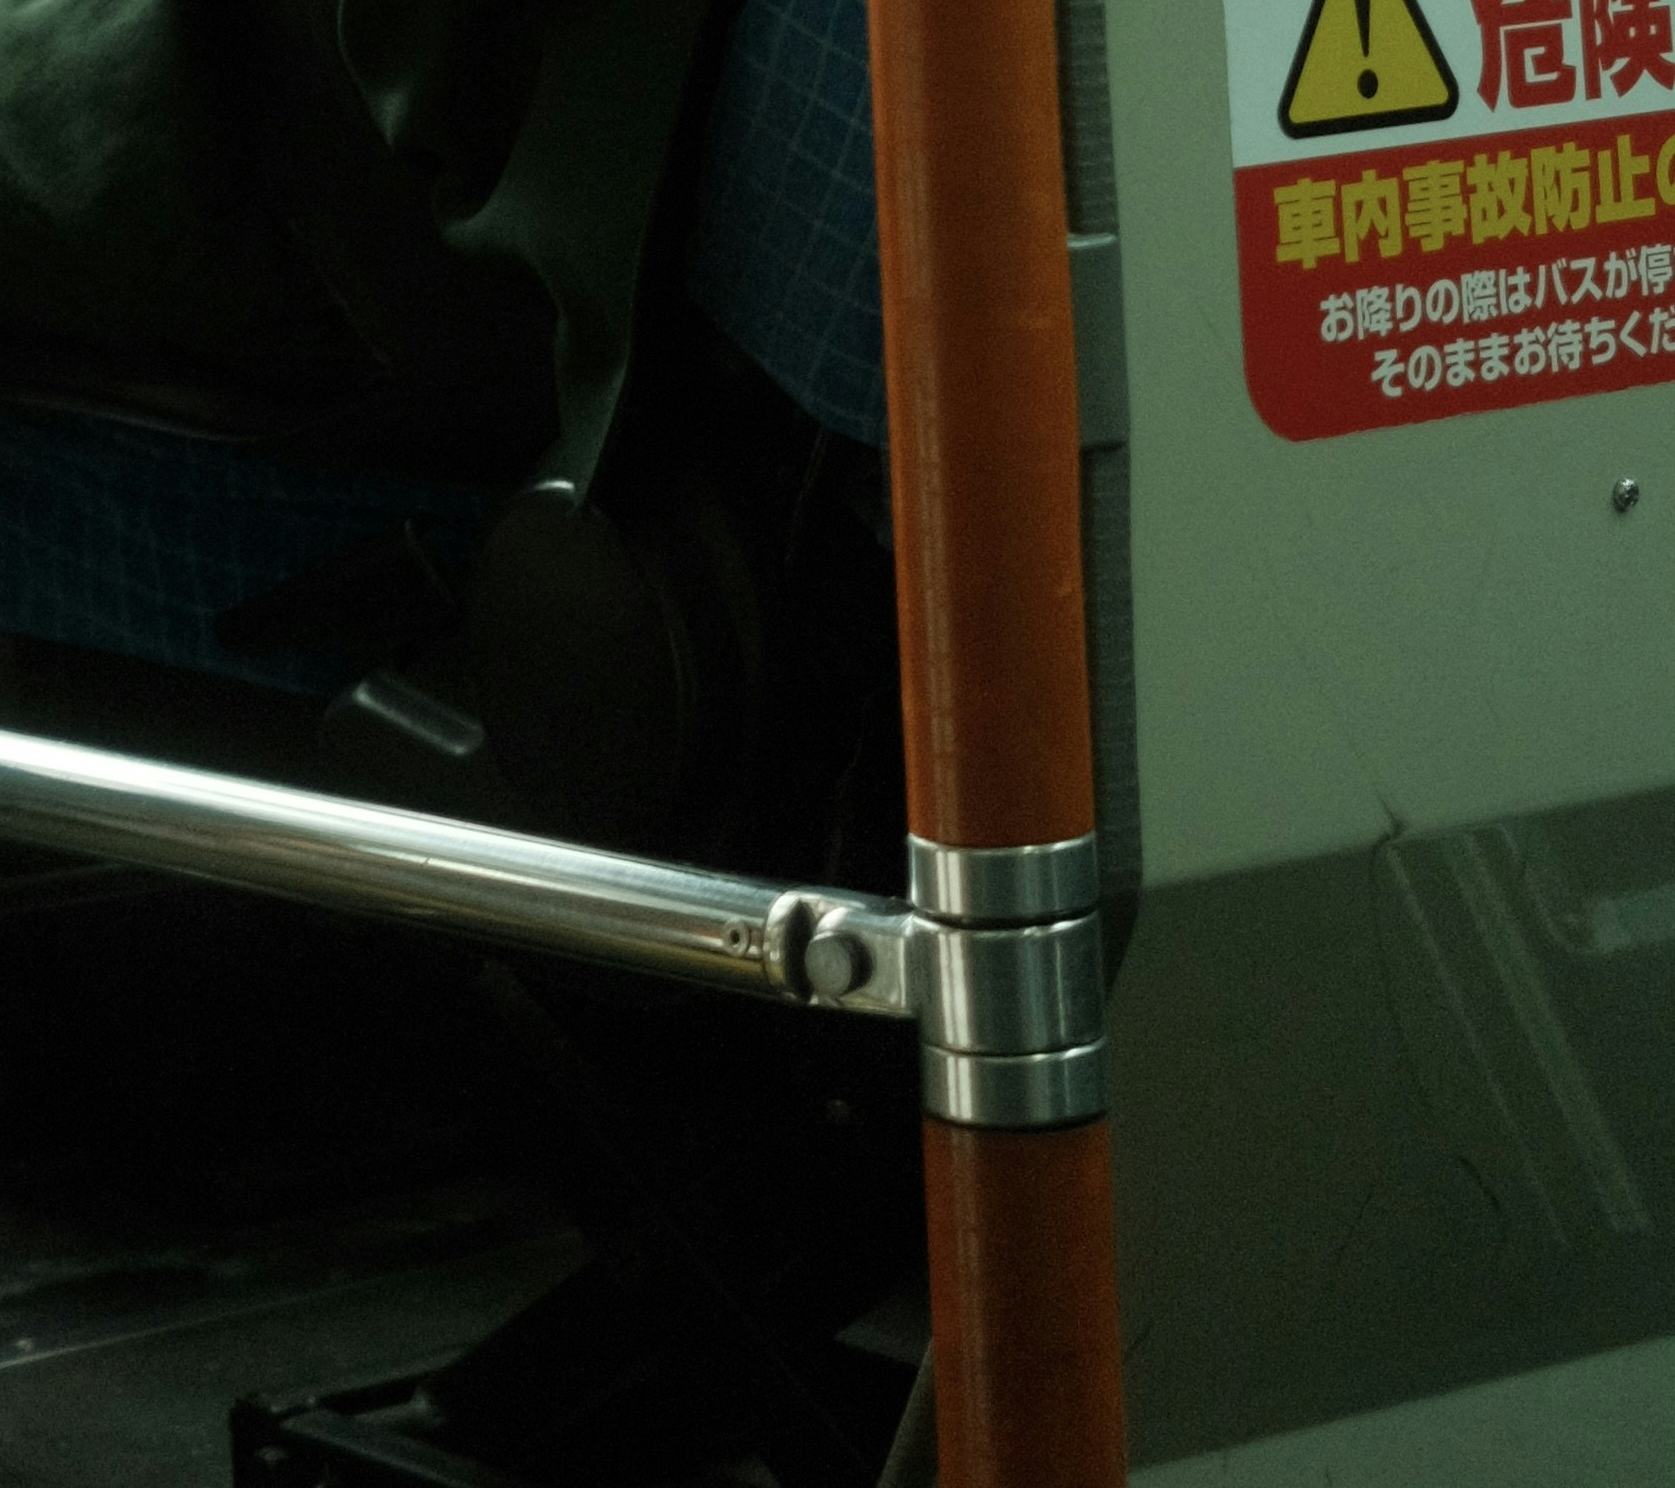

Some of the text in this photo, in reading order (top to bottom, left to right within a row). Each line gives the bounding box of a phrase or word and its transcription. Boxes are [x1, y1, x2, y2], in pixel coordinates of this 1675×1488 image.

[1320, 242, 1675, 343] お降りの際はバスが停
[1370, 304, 1675, 398] そのままお待ちくだ
